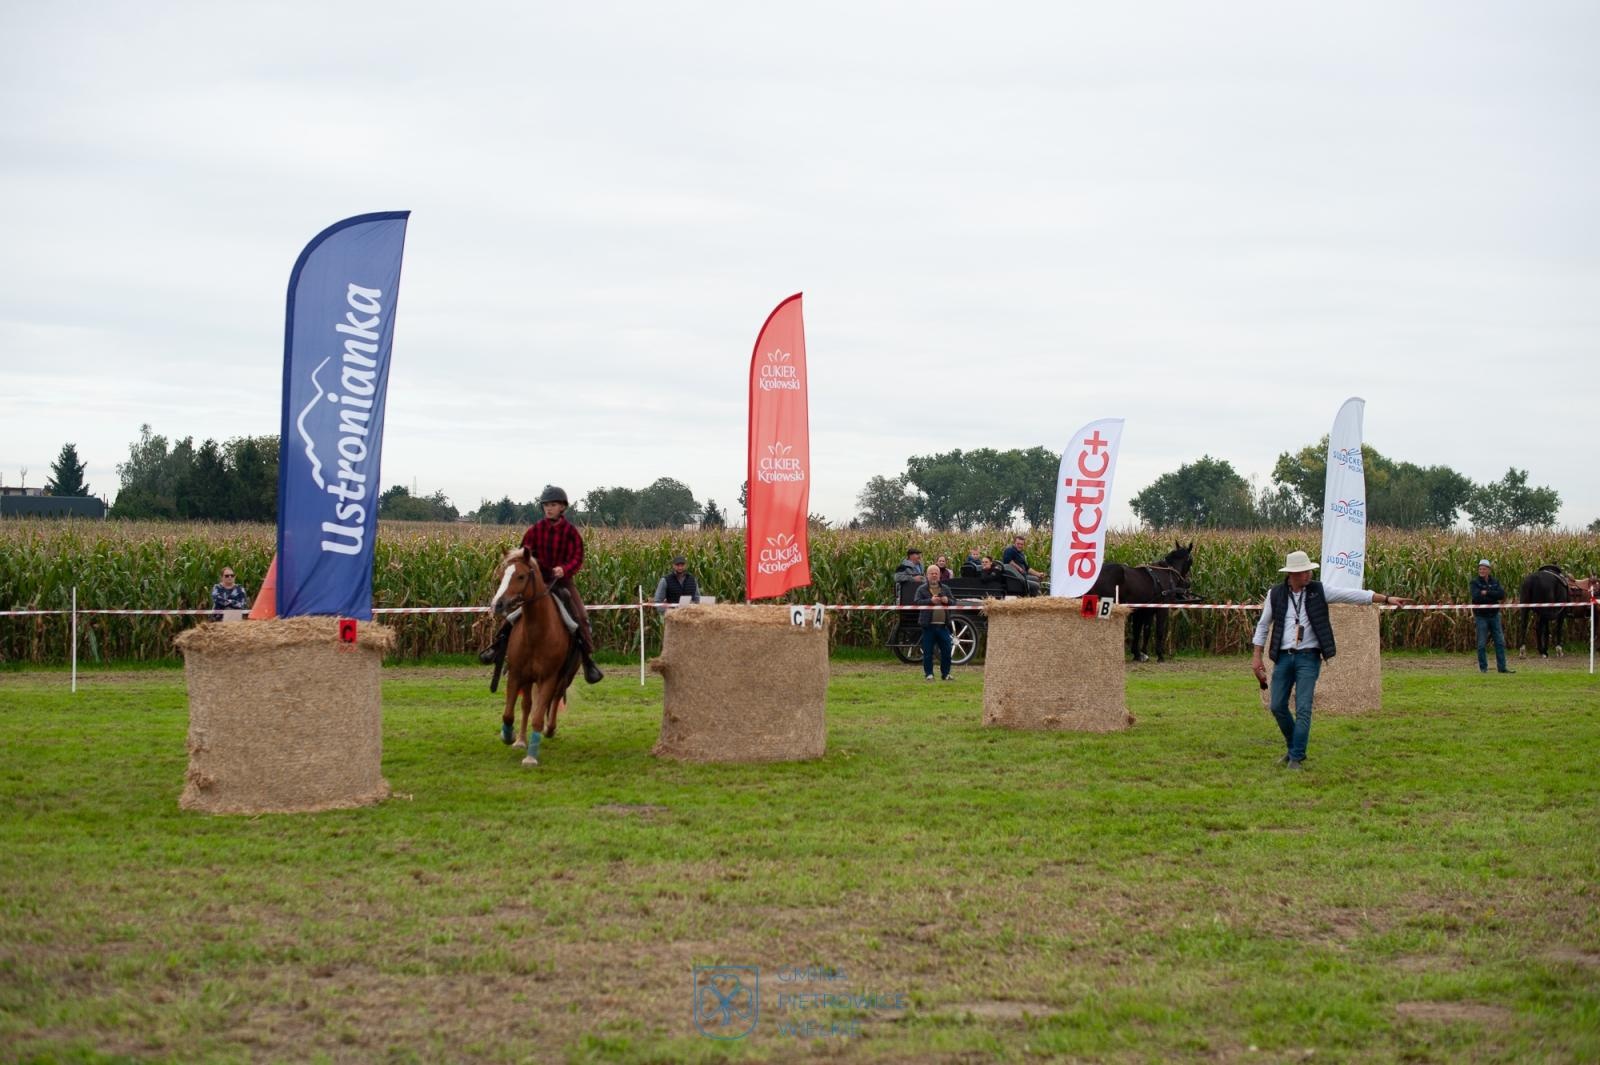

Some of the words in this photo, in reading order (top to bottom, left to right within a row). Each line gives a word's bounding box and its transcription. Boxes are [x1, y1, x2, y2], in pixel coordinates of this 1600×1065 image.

[761, 365, 797, 378] CUKIER
[321, 283, 382, 555] Ustronianka
[760, 457, 801, 470] CUKIER
[1065, 431, 1110, 579] arctic+
[760, 543, 798, 562] CUKIER
[1084, 600, 1095, 612] A
[1101, 601, 1110, 615] B
[793, 610, 802, 625] C
[815, 608, 822, 625] A
[342, 624, 353, 643] C
